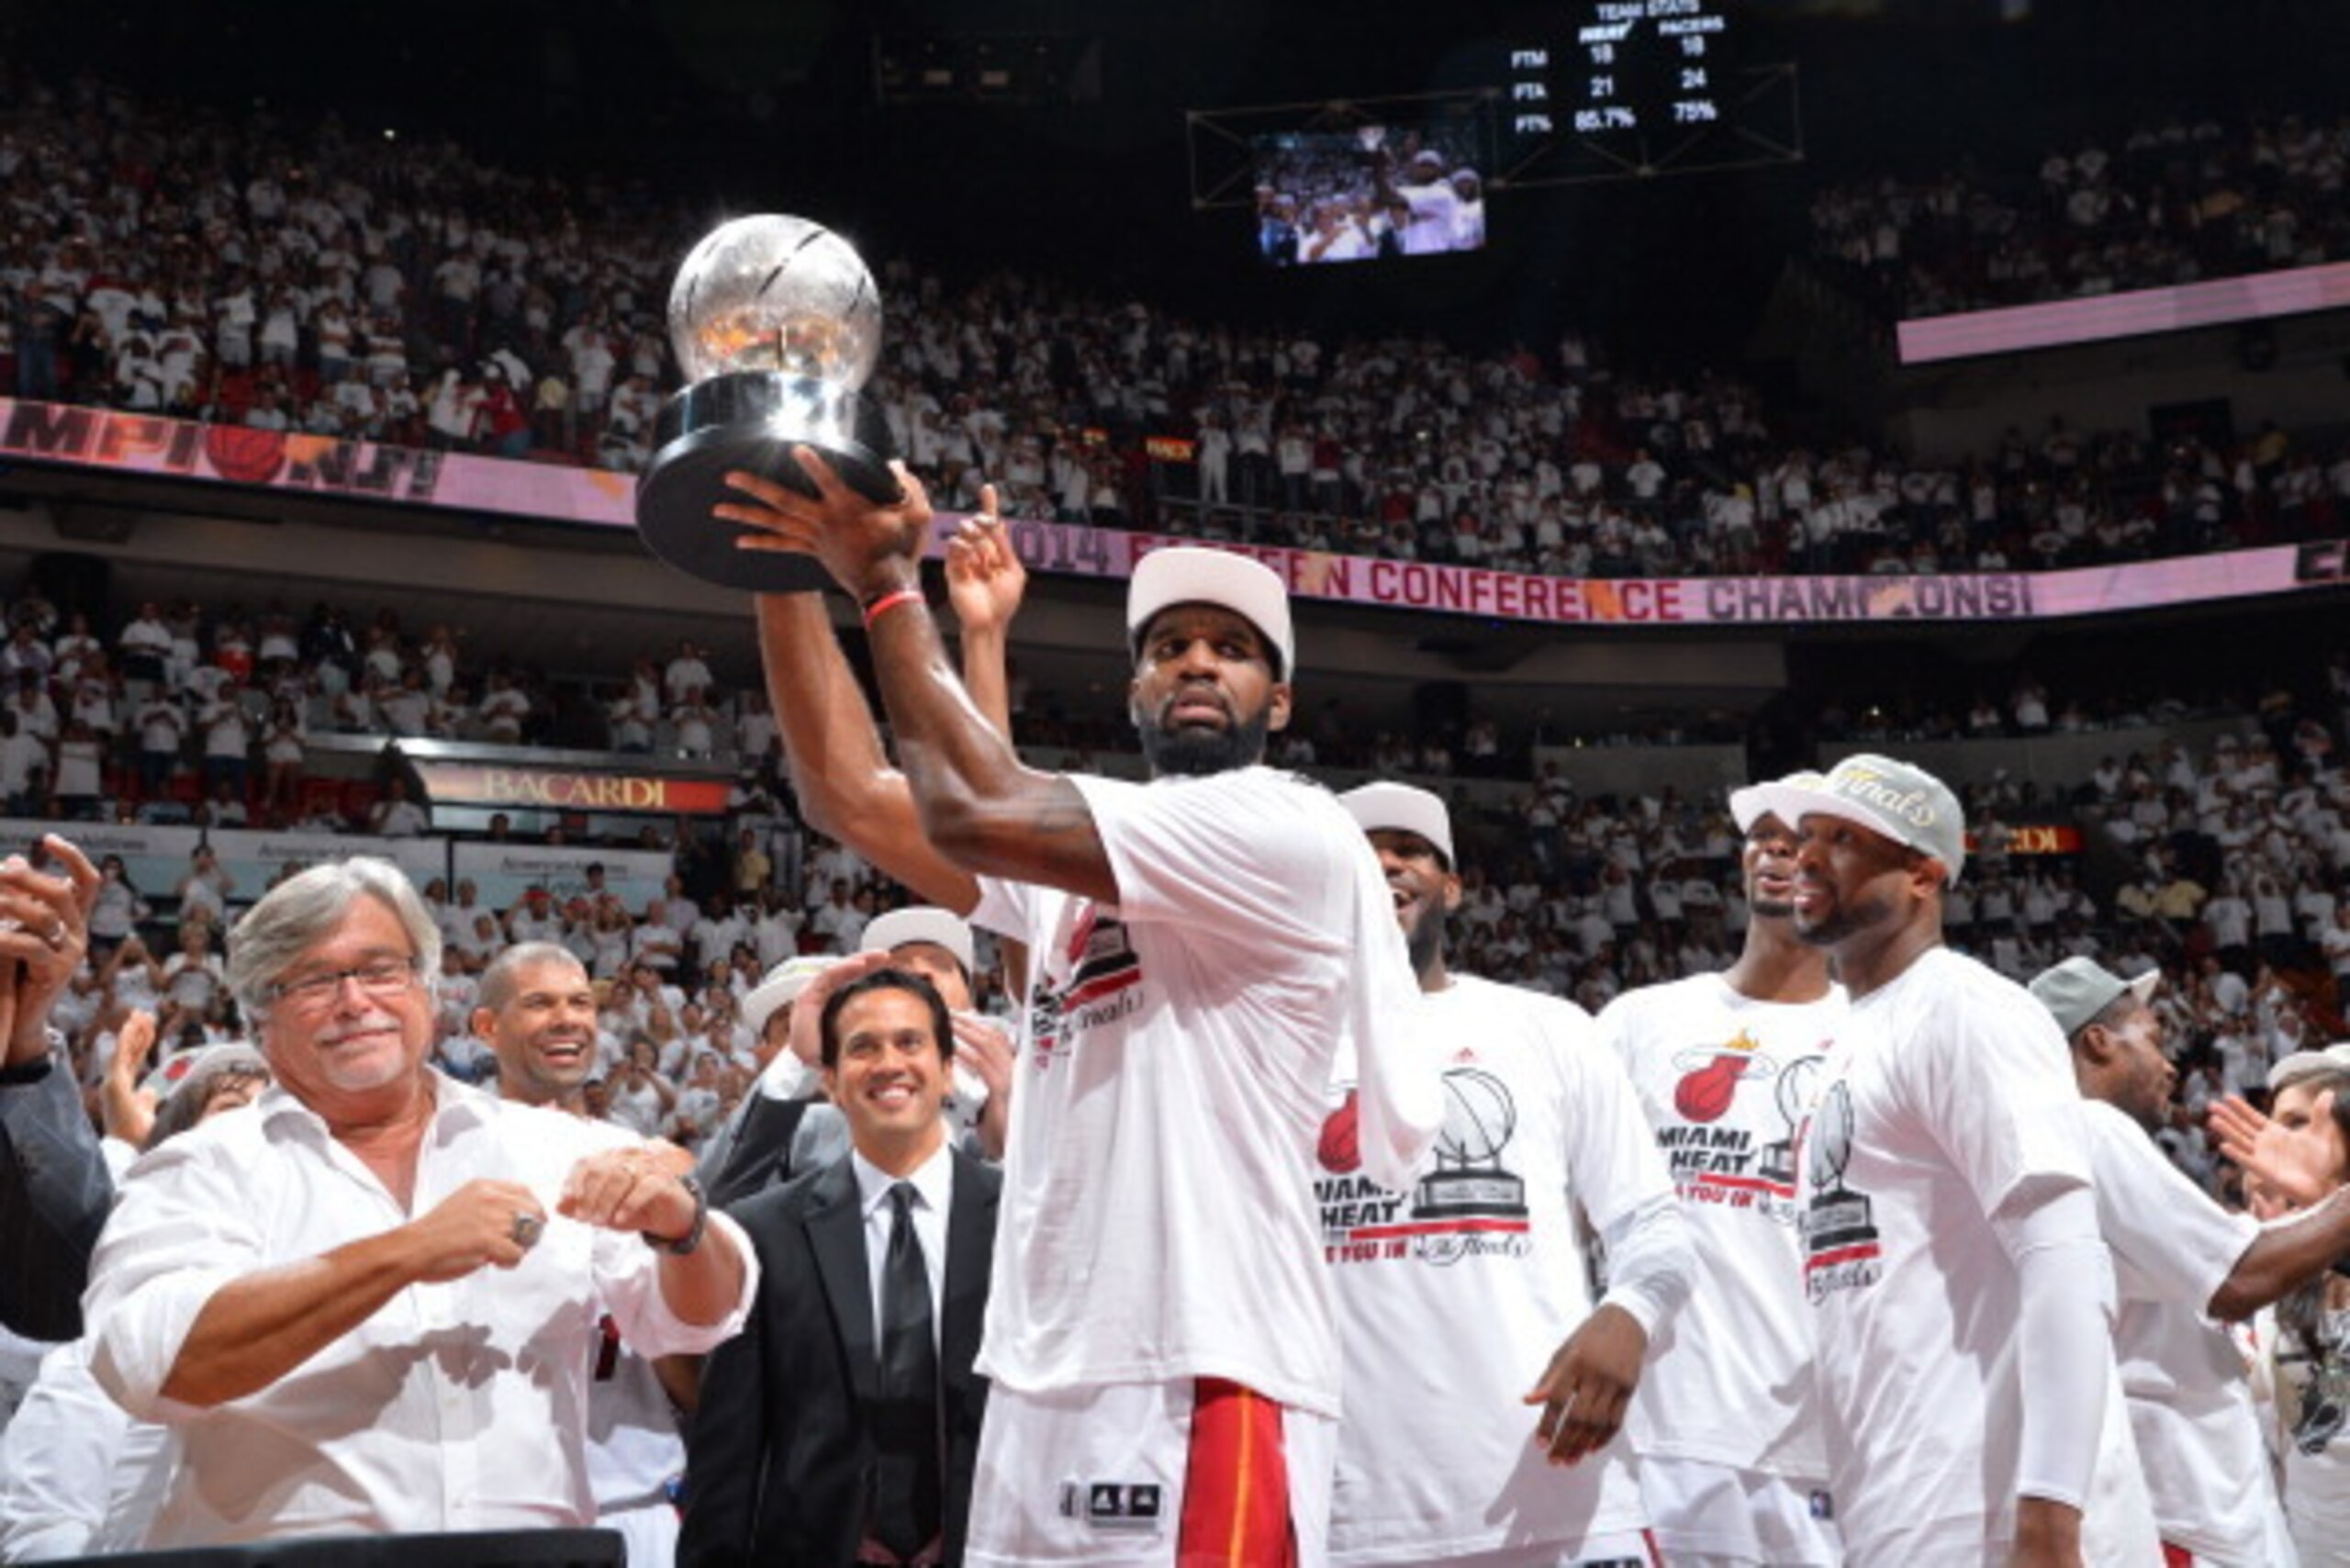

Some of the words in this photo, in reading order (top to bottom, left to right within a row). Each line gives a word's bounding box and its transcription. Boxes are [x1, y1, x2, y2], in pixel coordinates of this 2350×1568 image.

[1590, 75, 1615, 97] 21
[1681, 67, 1707, 89] 24
[482, 771, 665, 808] BACARDI
[1656, 1126, 1751, 1149] MIAMI
[1671, 1148, 1758, 1174] HEAT
[1320, 1192, 1406, 1227] HEAT
